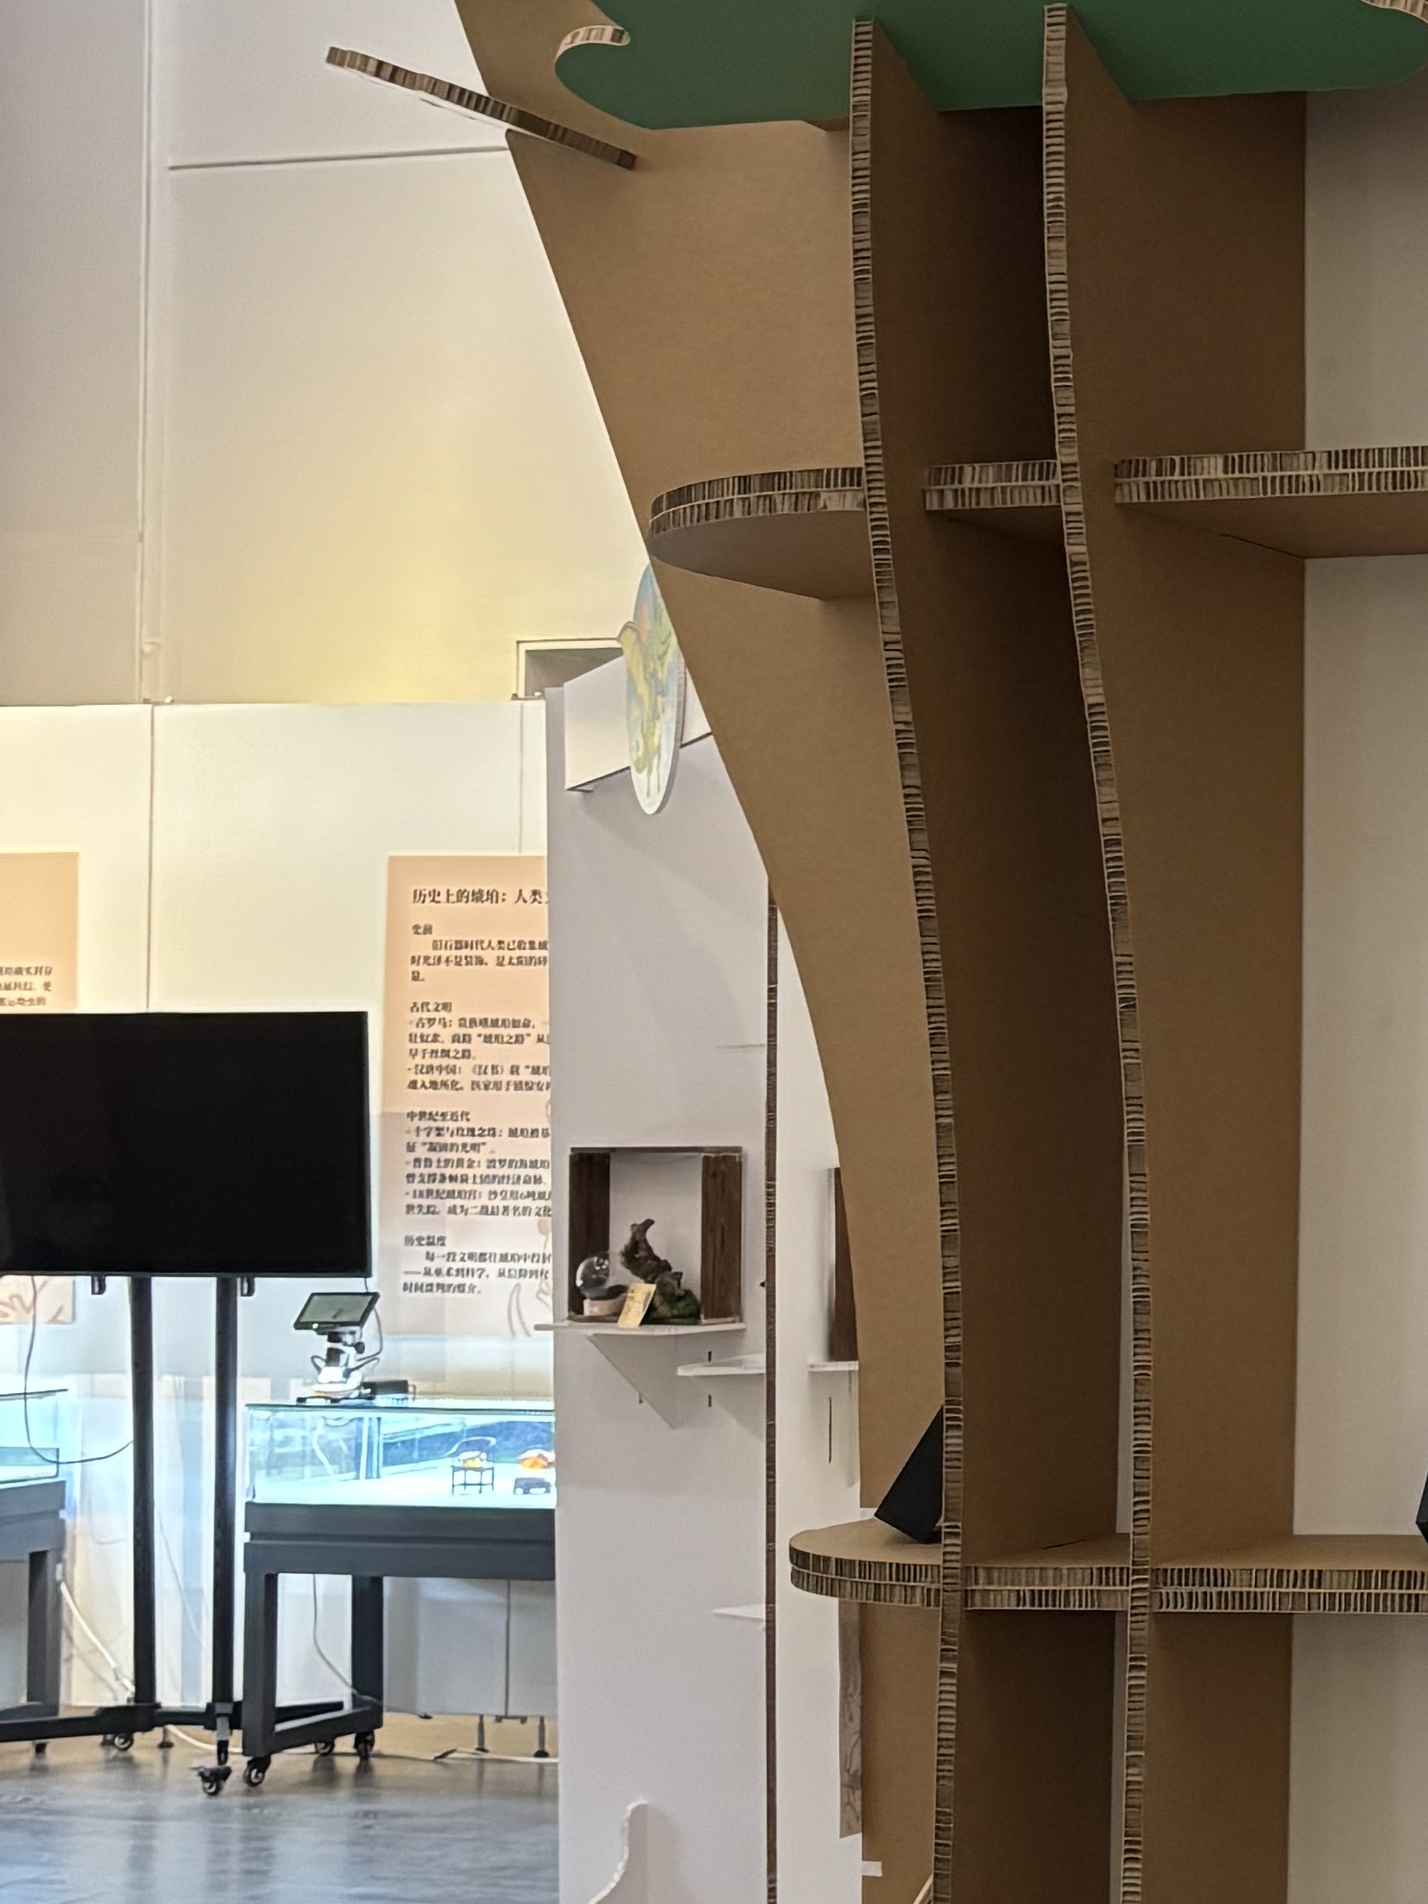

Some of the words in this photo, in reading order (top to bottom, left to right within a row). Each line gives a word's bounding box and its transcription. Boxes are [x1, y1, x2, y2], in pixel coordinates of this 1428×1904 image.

[412, 888, 549, 904] 历史上的琥珀：人类
